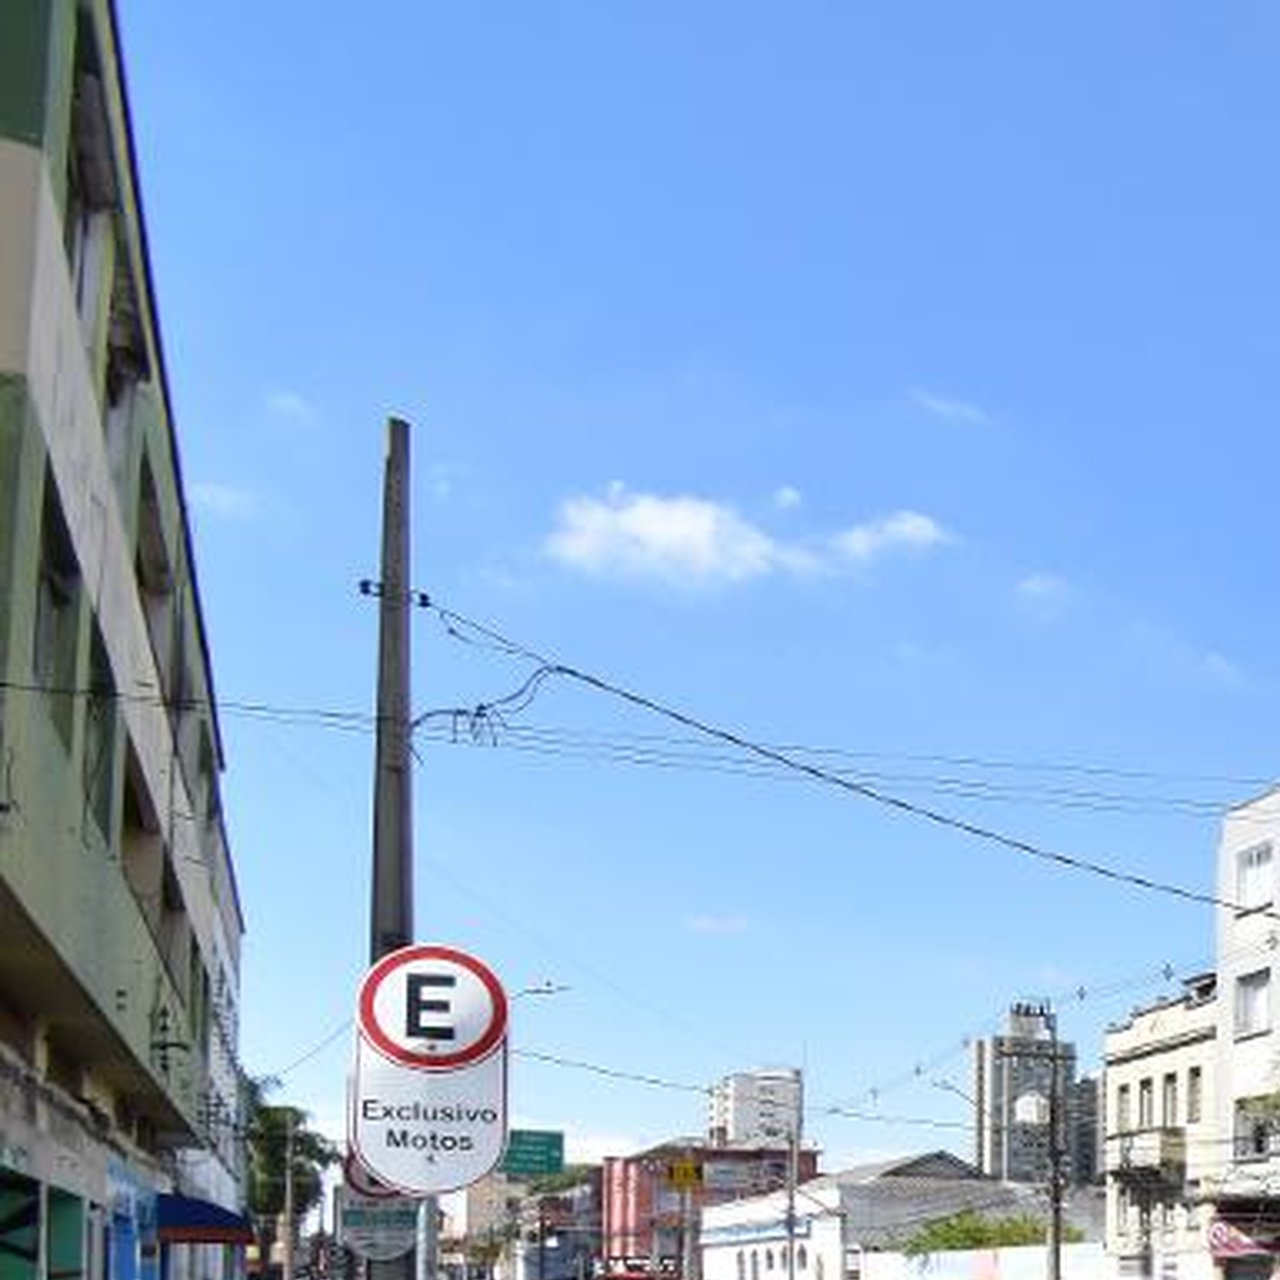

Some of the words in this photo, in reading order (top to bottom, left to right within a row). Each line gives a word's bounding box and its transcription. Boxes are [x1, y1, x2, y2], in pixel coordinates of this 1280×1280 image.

[406, 973, 456, 1041] E
[361, 1099, 498, 1124] Exclusivo
[386, 1130, 474, 1151] Motos
